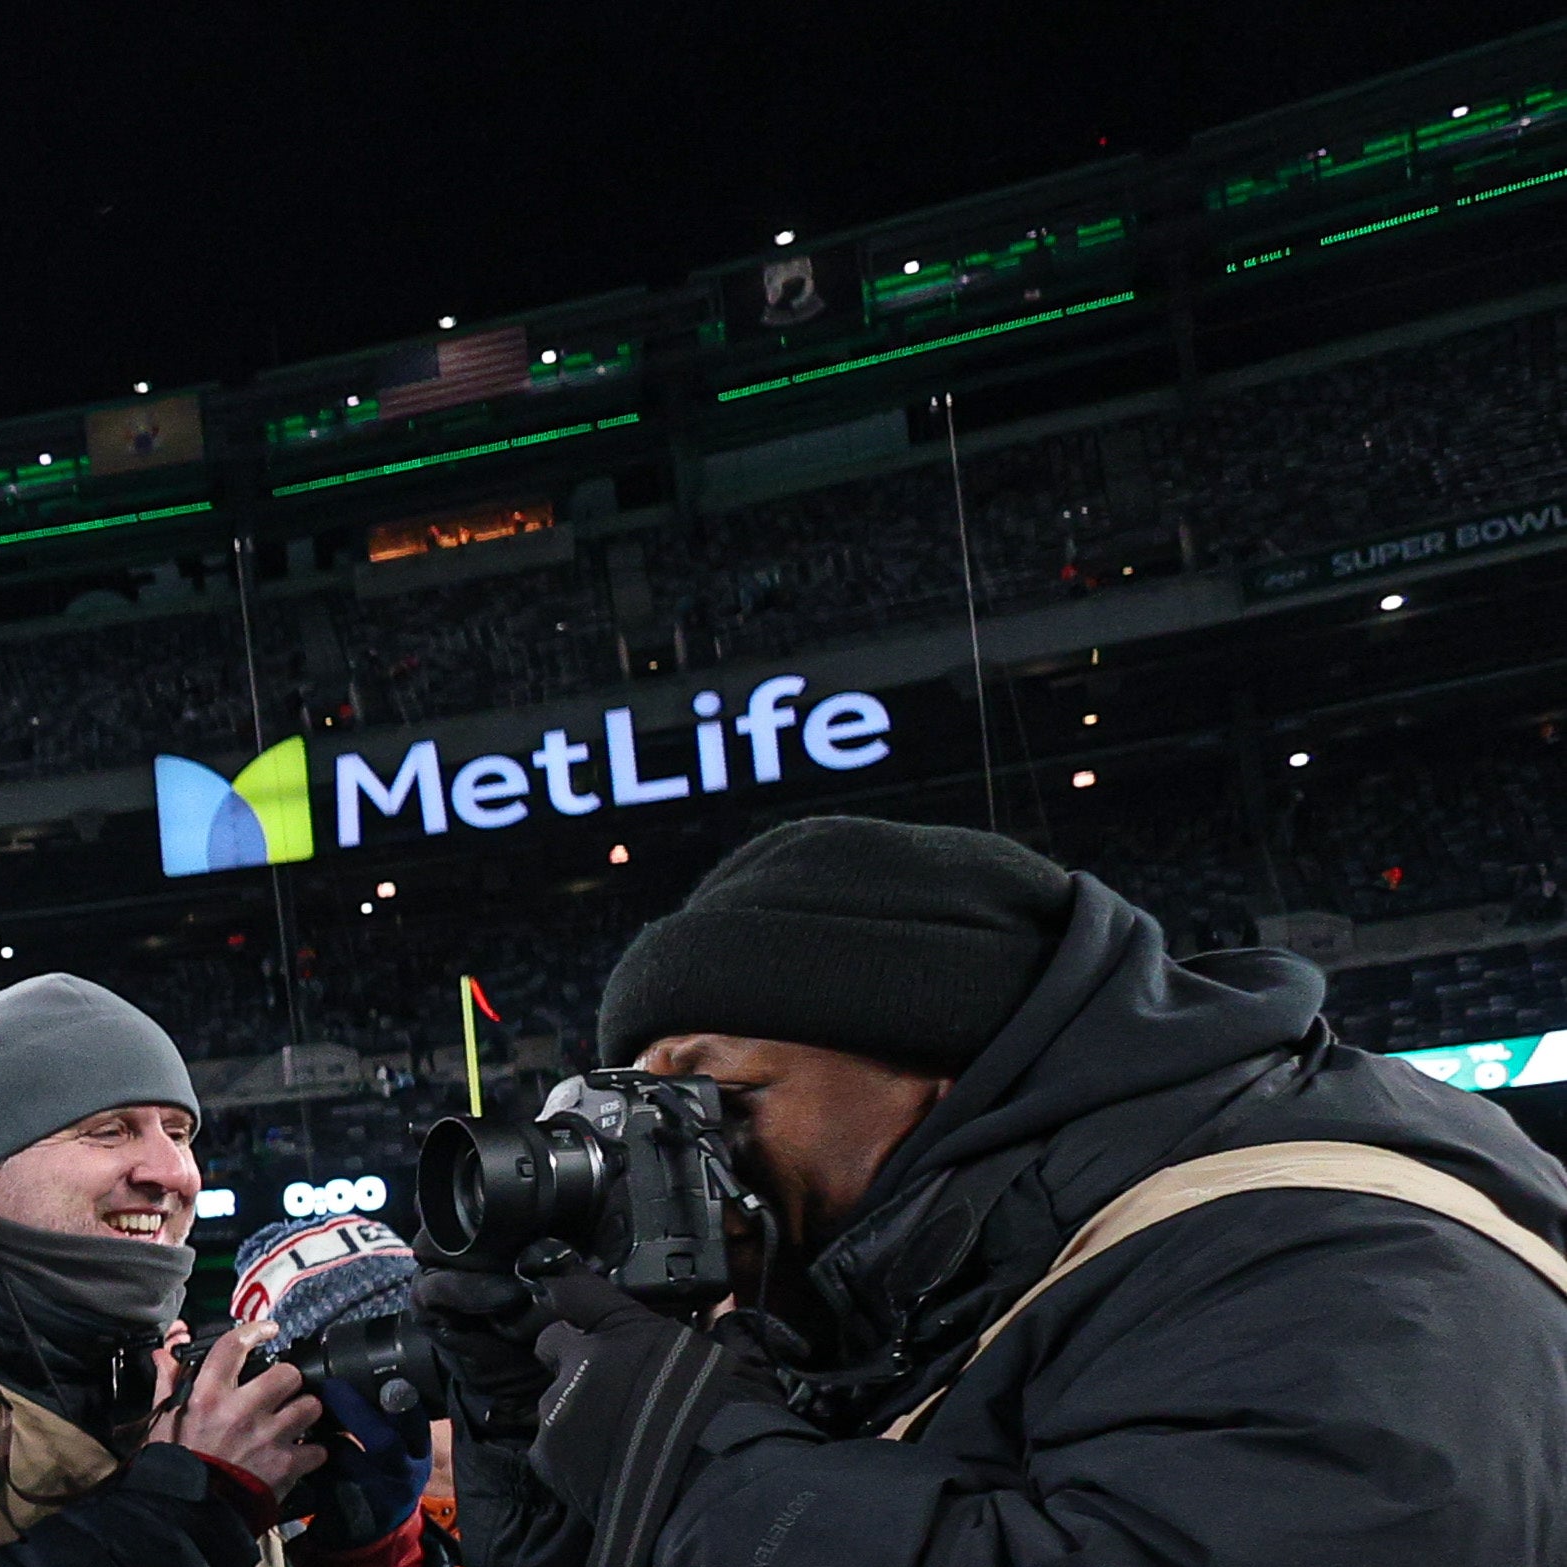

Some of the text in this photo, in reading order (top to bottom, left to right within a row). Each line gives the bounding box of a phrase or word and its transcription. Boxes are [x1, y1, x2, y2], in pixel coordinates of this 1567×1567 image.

[1332, 504, 1567, 578] SUPER BOWL
[336, 675, 891, 848] MetLife
[284, 1176, 387, 1217] 0:00
